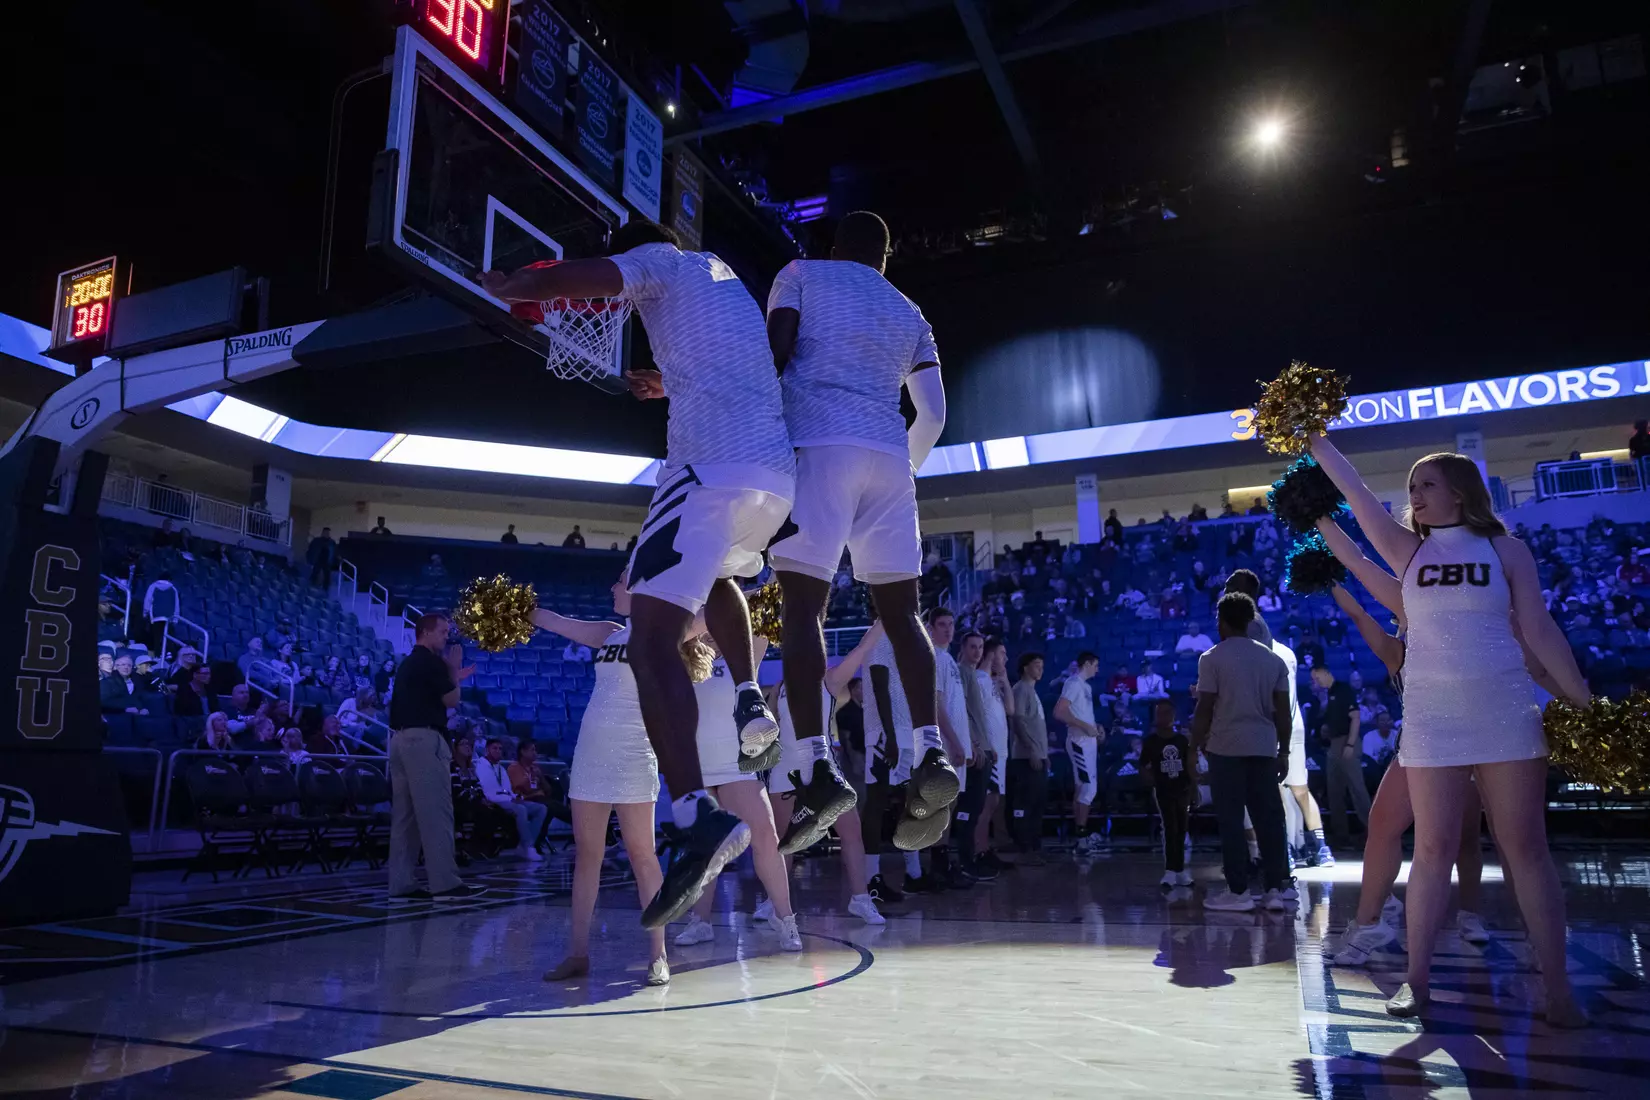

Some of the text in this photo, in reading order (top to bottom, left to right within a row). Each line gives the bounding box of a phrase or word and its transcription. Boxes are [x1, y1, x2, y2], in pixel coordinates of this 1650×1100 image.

[533, 4, 560, 37] 2017
[587, 60, 611, 90] 2017
[635, 108, 656, 135] 2017
[400, 241, 429, 266] SPALDING
[71, 264, 110, 281] DAKTRONICS
[75, 302, 104, 337] 30
[225, 327, 293, 357] SPALDING
[1407, 366, 1621, 420] FLAVORS
[1416, 563, 1491, 587] CBU
[16, 543, 81, 740] CBU
